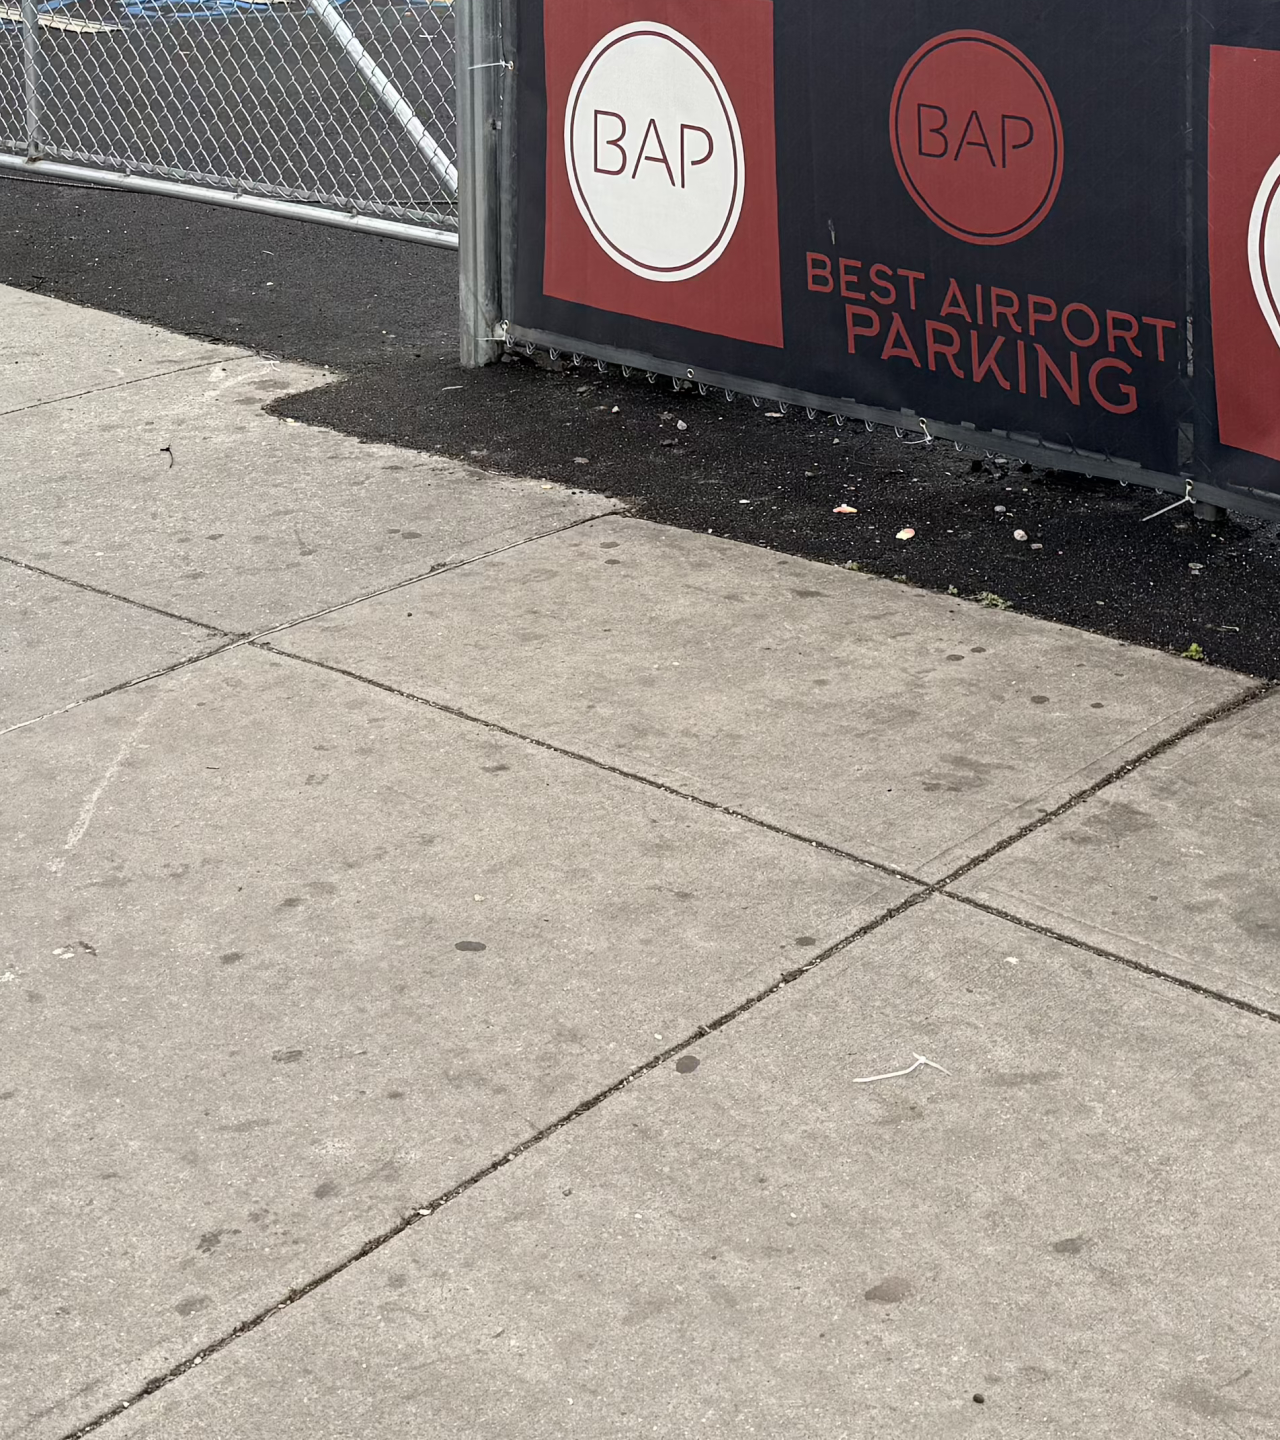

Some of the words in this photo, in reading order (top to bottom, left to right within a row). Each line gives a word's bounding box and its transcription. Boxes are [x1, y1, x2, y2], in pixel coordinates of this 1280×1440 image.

[593, 109, 715, 189] BAP
[917, 102, 1035, 168] BAP
[806, 252, 925, 311] BEST
[940, 277, 1177, 362] AIRPORT
[845, 304, 1139, 415] PARKING
